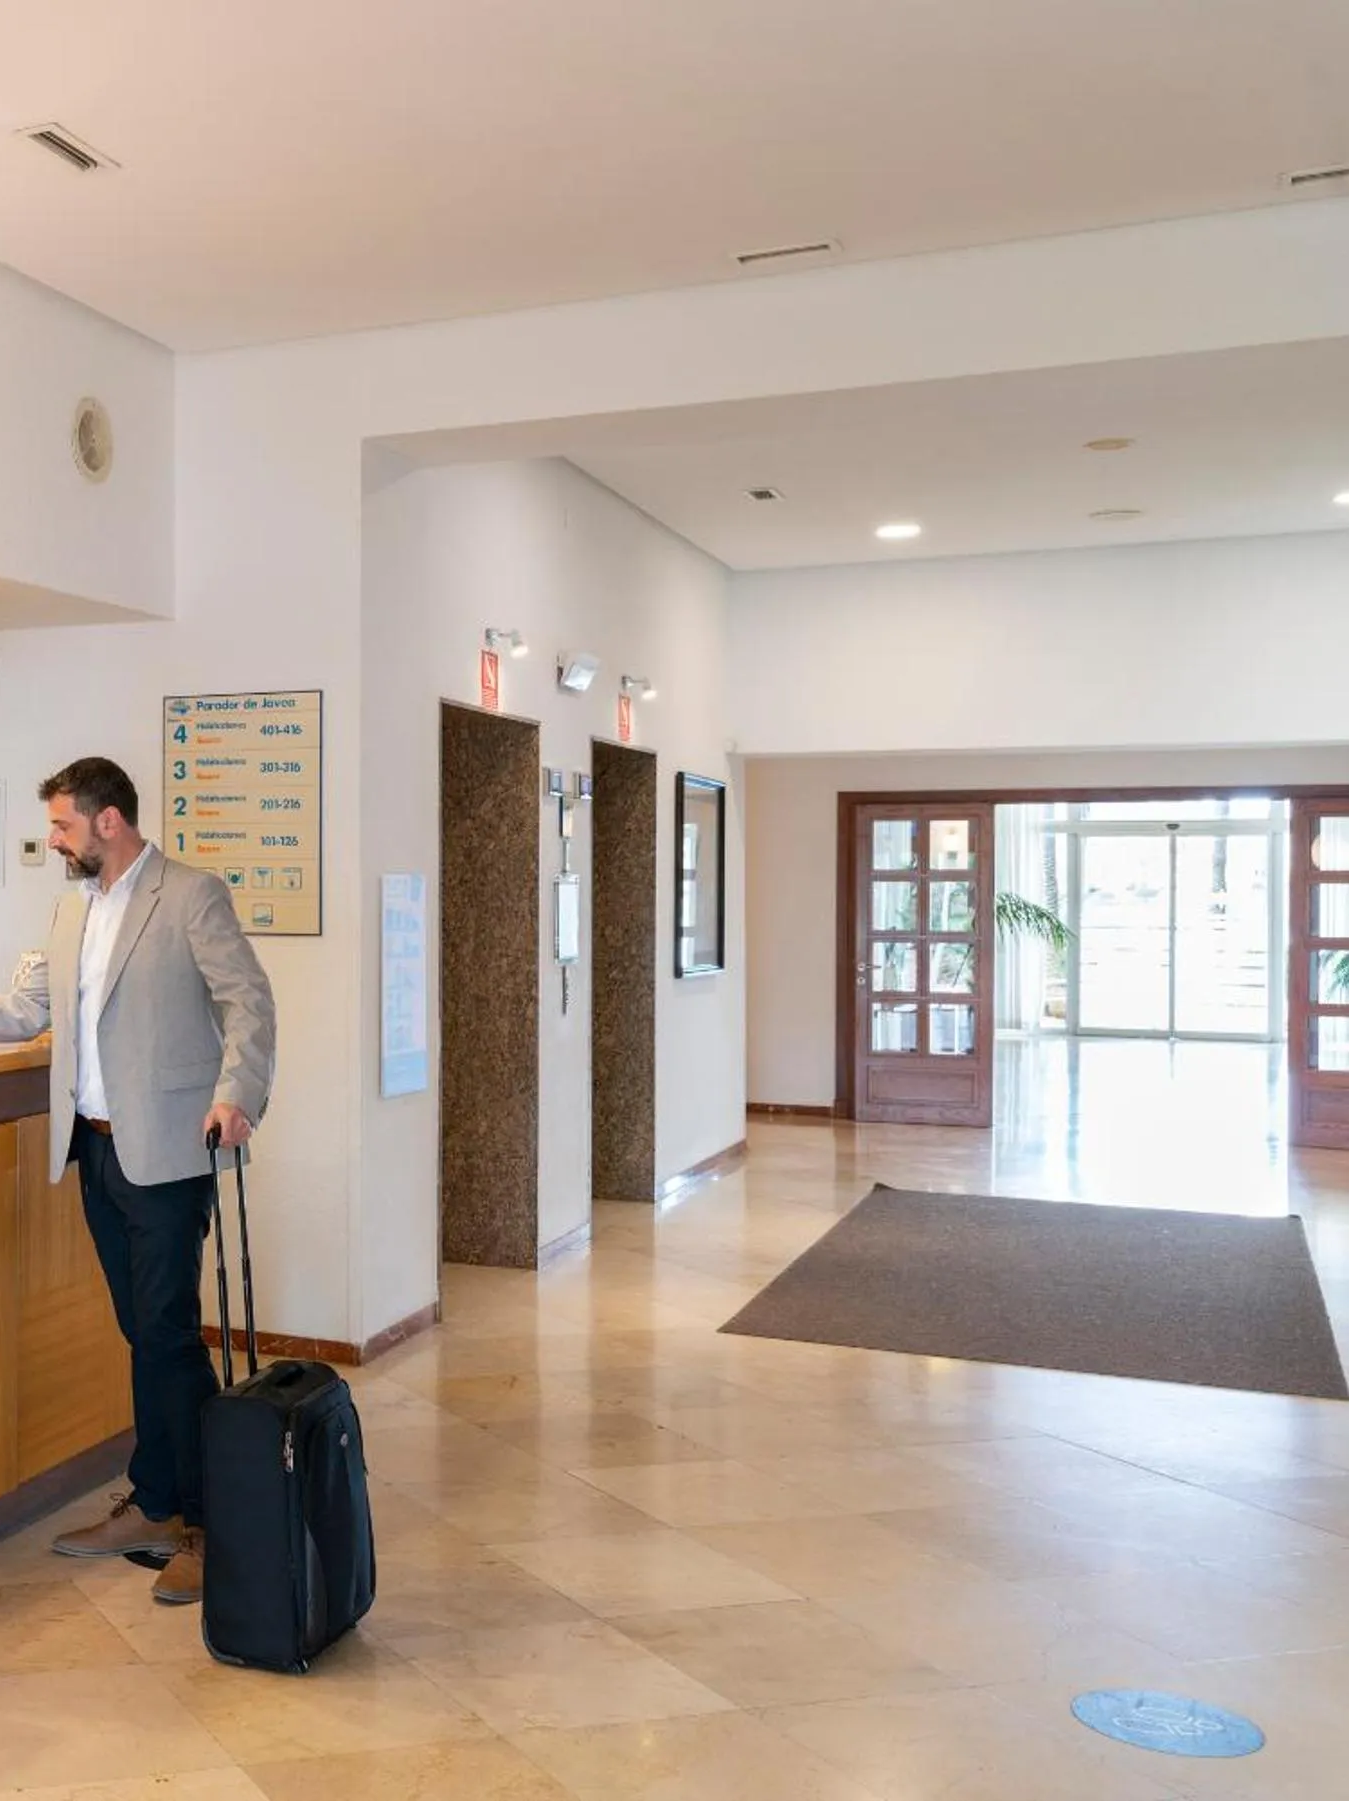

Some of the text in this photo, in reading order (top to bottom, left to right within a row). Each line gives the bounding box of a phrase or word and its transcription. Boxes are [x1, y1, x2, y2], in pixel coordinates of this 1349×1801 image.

[196, 699, 239, 711] Parador
[243, 699, 258, 709] de
[173, 724, 188, 743] 4
[259, 724, 302, 736] 401-416
[173, 761, 187, 780] 3
[260, 762, 301, 773] 301-316
[173, 797, 187, 816] 2
[260, 798, 301, 810] 201-216
[175, 832, 185, 852] 1
[261, 836, 299, 847] 101-126
